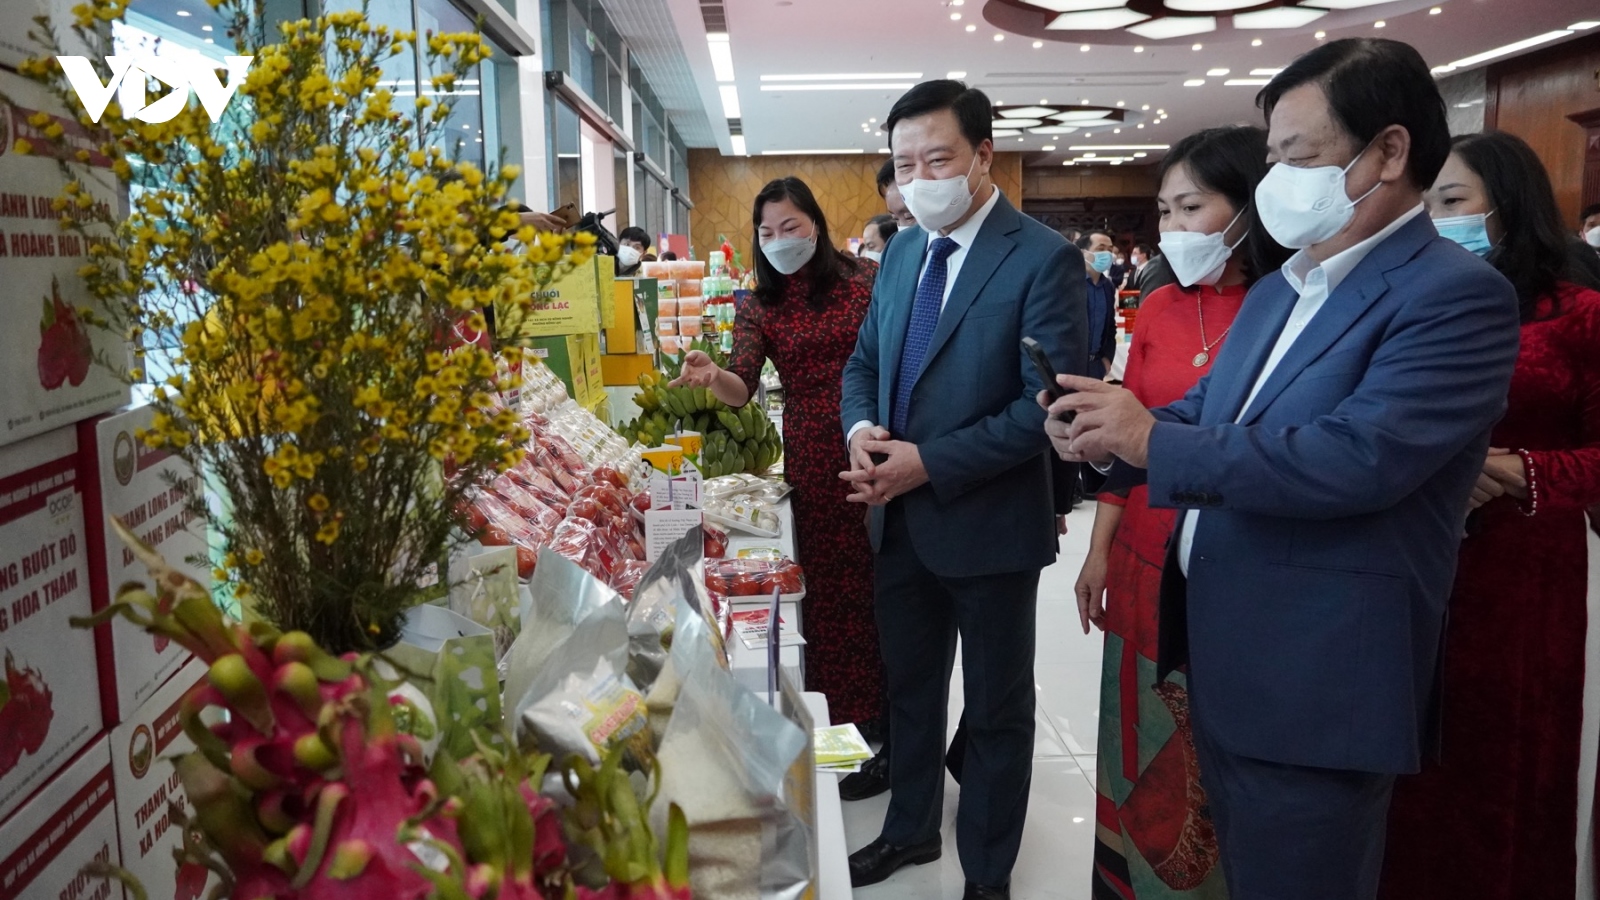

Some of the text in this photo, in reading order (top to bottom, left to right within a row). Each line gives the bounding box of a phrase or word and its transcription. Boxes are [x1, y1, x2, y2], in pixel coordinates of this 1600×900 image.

[58, 234, 81, 258] HOA
[552, 301, 570, 311] LẠC
[21, 542, 56, 580] RUỘT
[60, 528, 77, 561] ĐỎ
[12, 590, 41, 626] HOA
[134, 782, 167, 830] THANH
